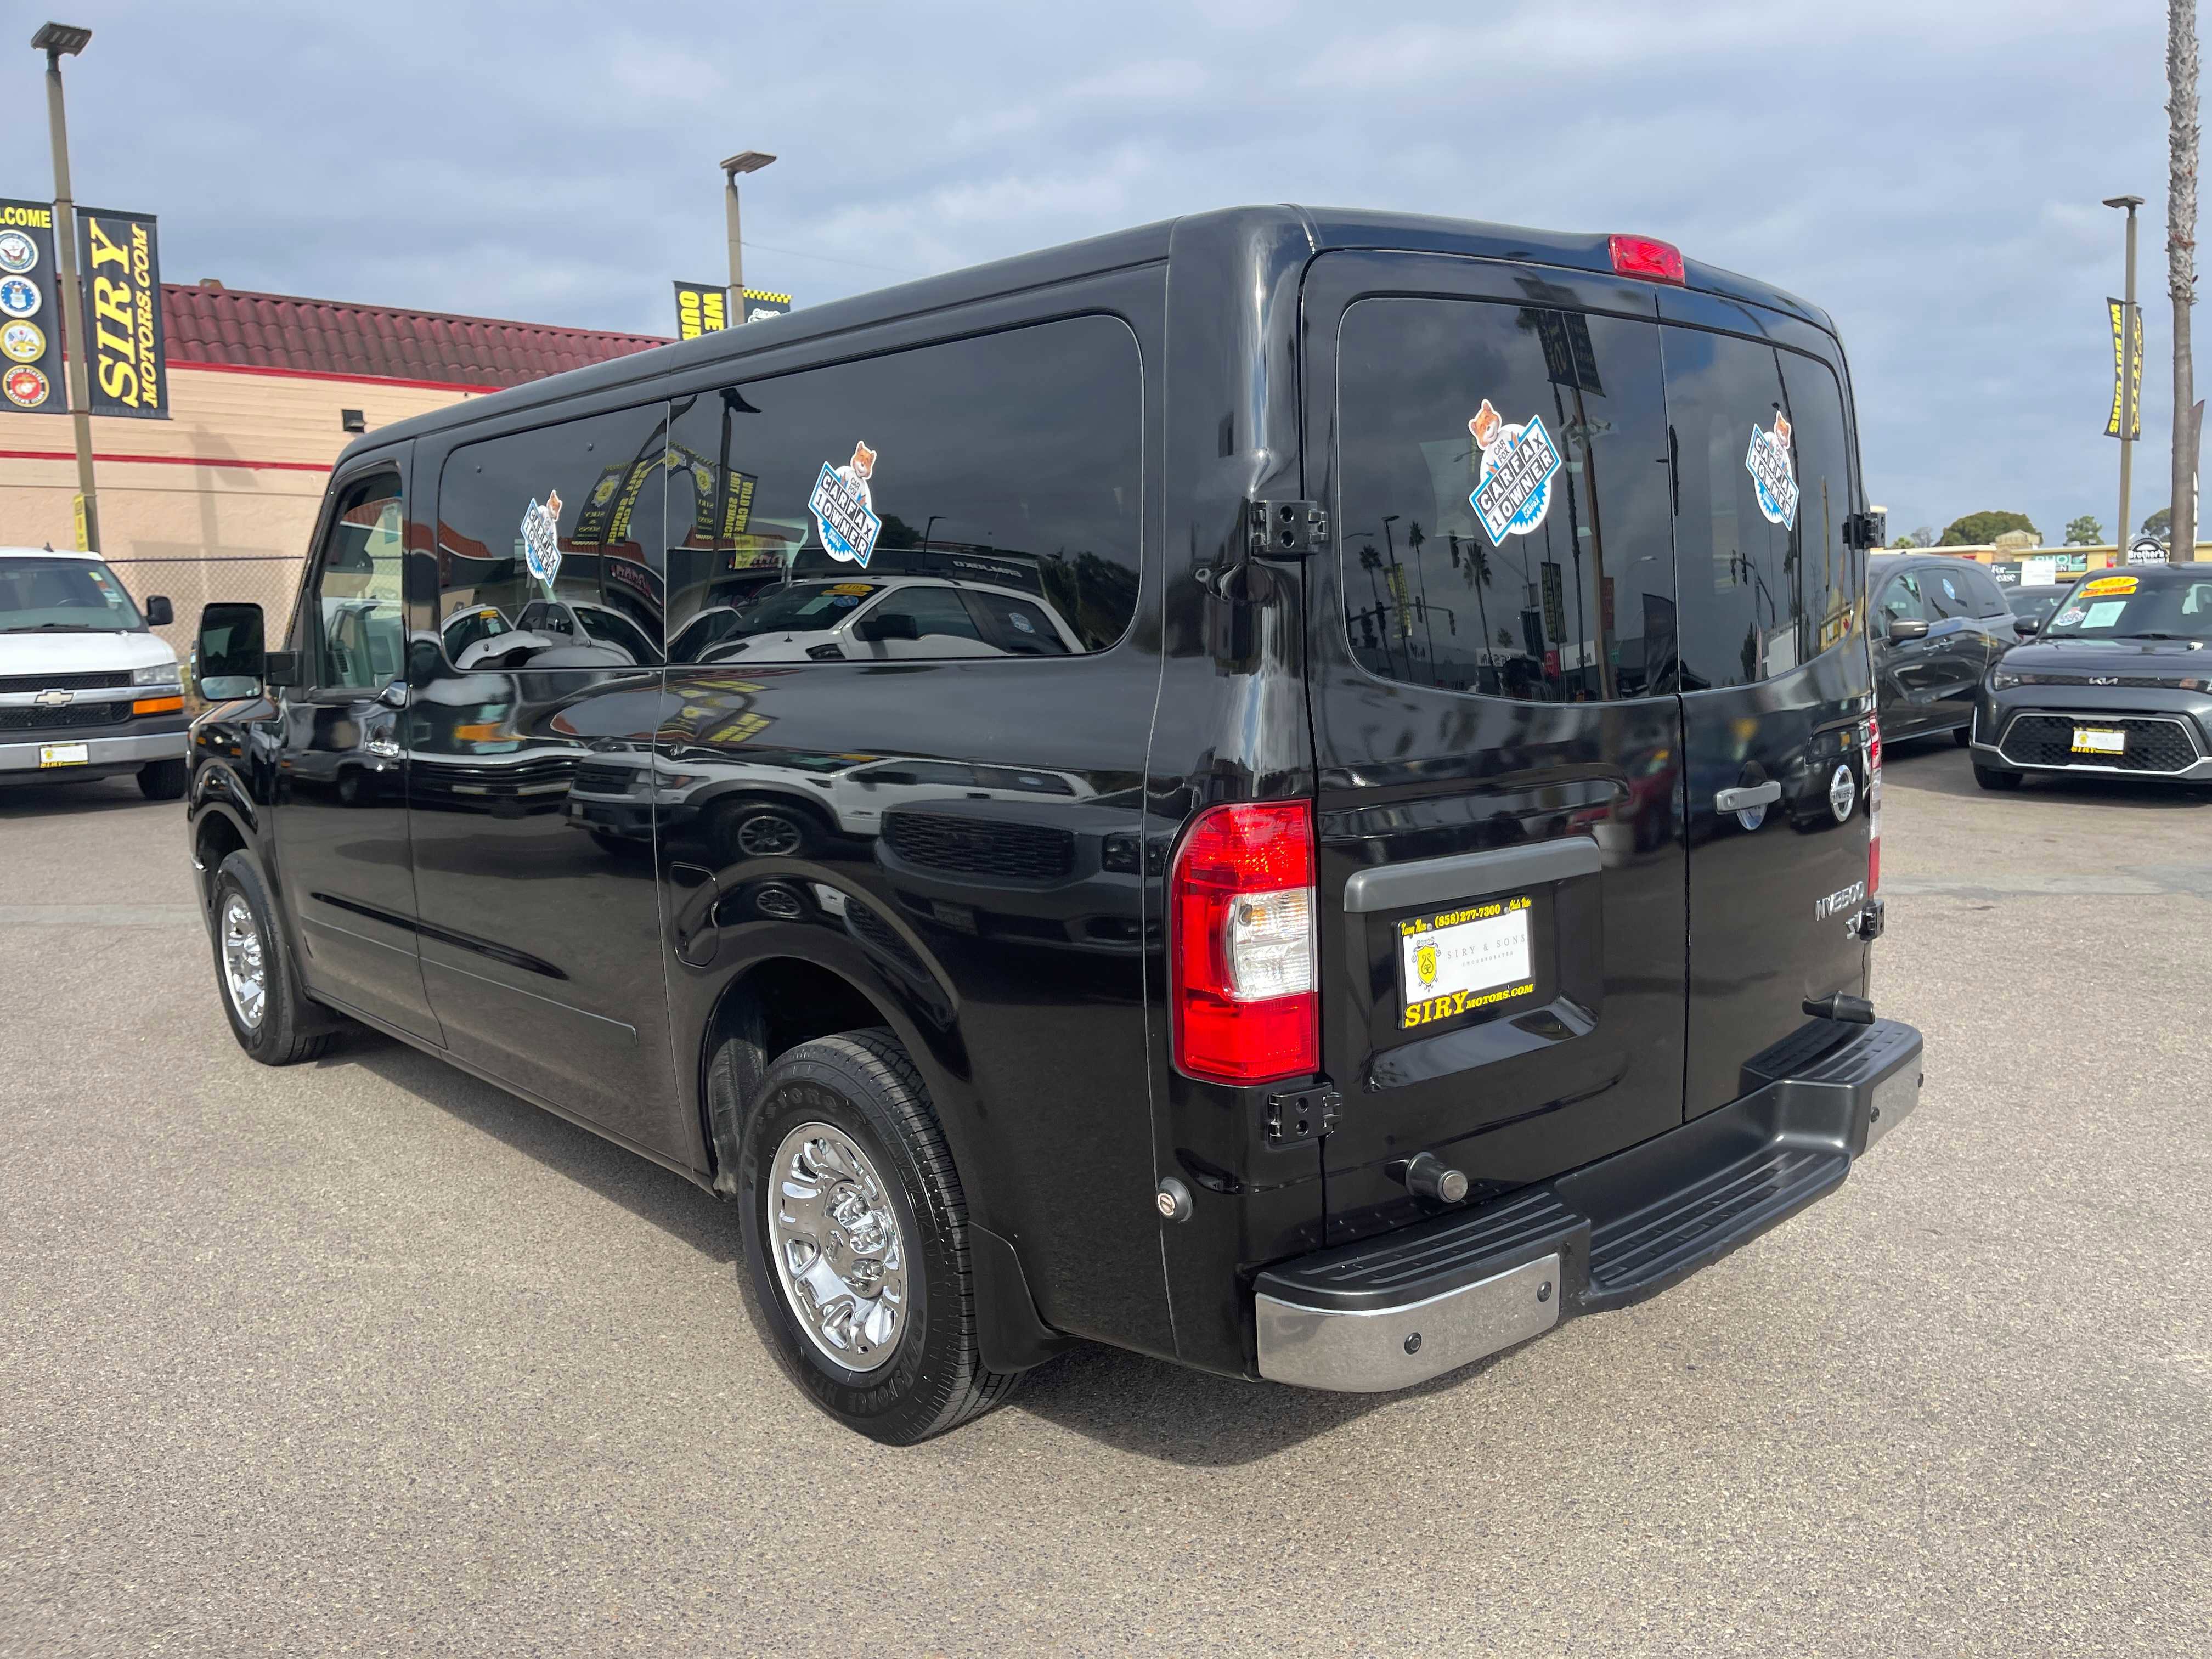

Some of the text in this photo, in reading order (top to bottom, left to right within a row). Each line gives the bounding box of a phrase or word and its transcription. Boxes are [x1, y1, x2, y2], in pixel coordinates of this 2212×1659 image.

[89, 217, 139, 408] SIRY
[131, 223, 158, 409] MOTORS.COM
[703, 292, 724, 331] WE
[2110, 304, 2121, 335] WE
[2108, 380, 2122, 433] CARS
[1493, 440, 1506, 455] CAR
[1498, 449, 1510, 464] FOX
[850, 477, 860, 490] CAR
[1480, 433, 1544, 511] CARFAX
[1491, 515, 1502, 531] 1
[1501, 450, 1553, 518] OWNER
[1755, 437, 1794, 506] CARFAX
[1759, 467, 1791, 518] OWNER
[816, 494, 868, 557] 1 OWNER
[823, 475, 873, 538] CARFAX
[529, 532, 553, 578] OWNER
[530, 509, 556, 566] CARFAX
[2128, 549, 2165, 559] Brother's
[1996, 574, 2016, 582] ease
[1435, 911, 1459, 928] (858)
[1460, 904, 1500, 922] 277-7300
[1447, 934, 1526, 960] SIRY & SONS
[1405, 983, 1534, 1028] SIRY MOTORS.COM
